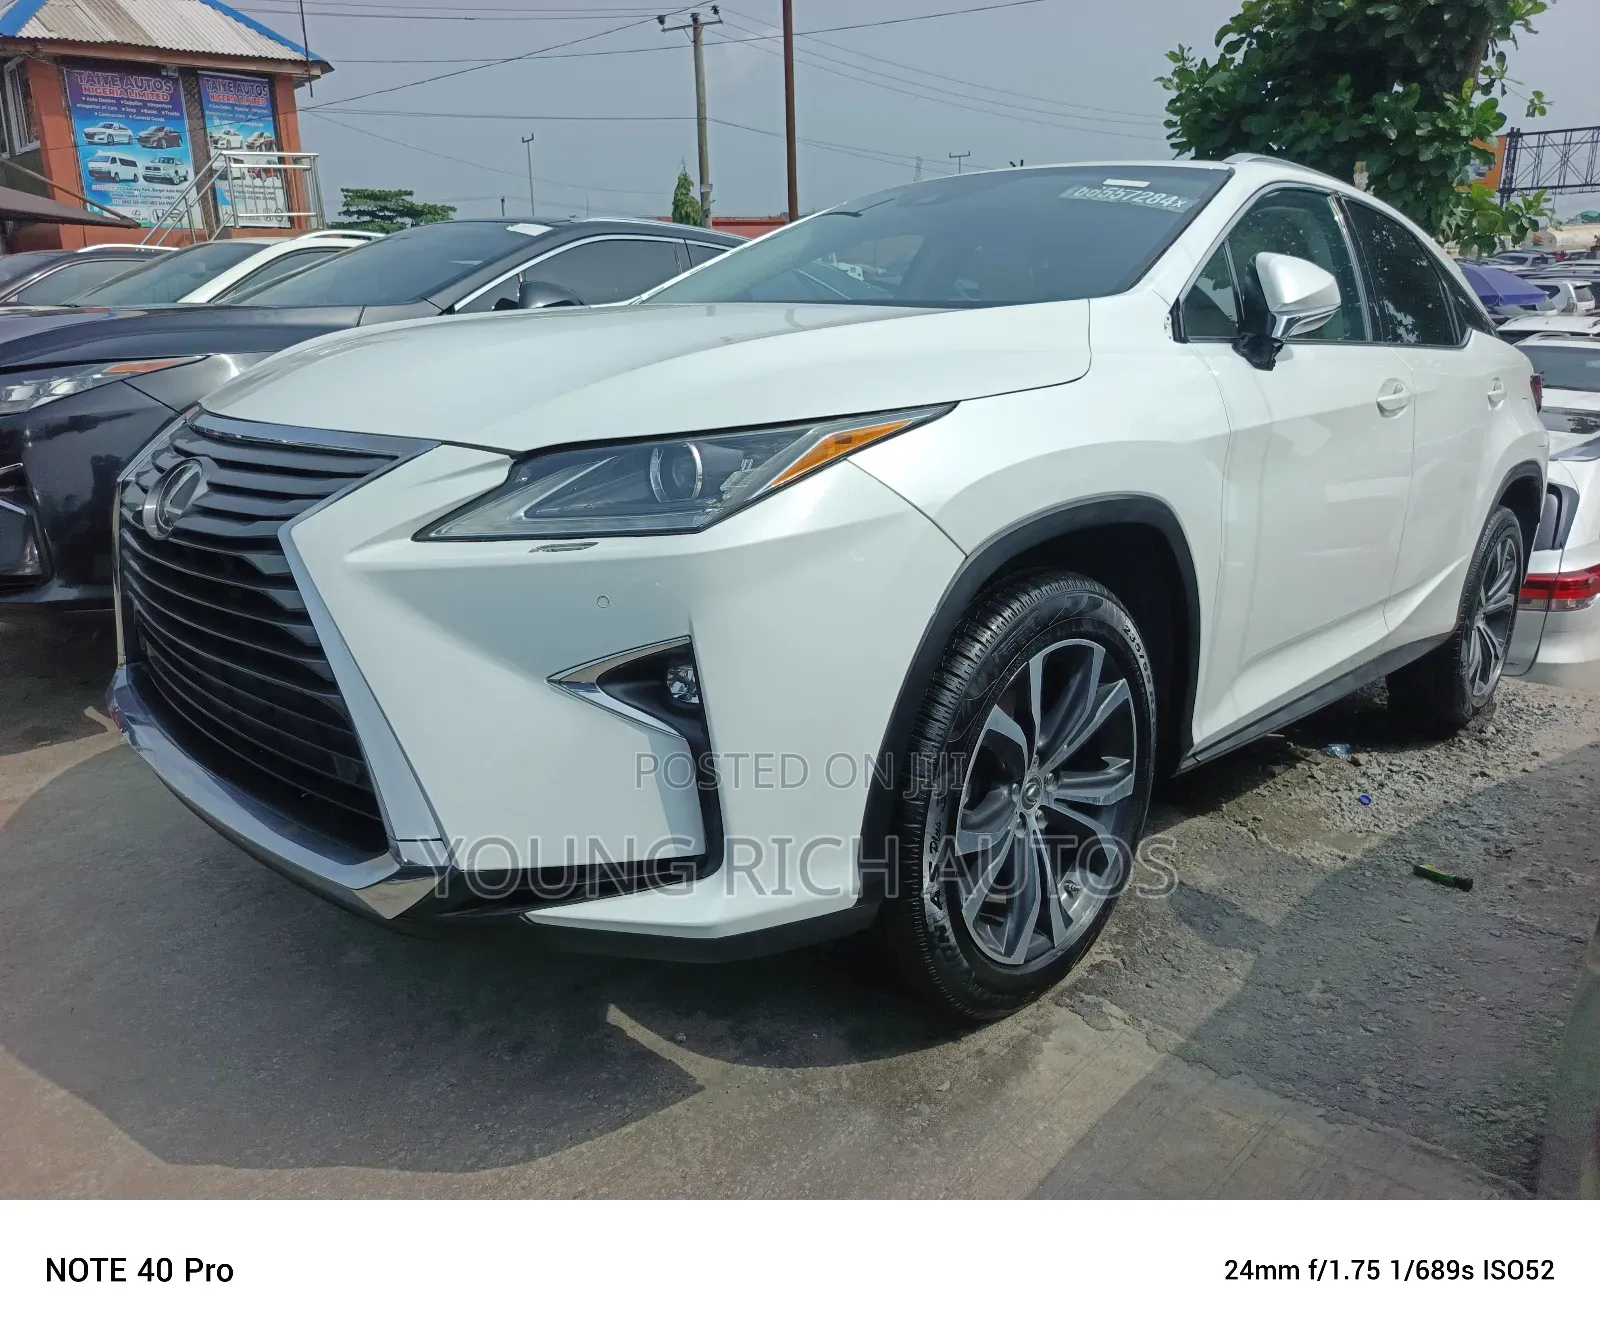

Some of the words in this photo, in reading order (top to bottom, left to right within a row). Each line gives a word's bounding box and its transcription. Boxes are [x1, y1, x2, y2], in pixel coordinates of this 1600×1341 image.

[74, 69, 120, 88] TAIYE
[122, 75, 174, 94] AUTOS
[203, 77, 235, 95] TAIYE
[235, 81, 270, 98] AUTOS
[82, 85, 127, 99] NIGERIA
[127, 90, 170, 102] LIMITED
[209, 93, 239, 105] NIGERIA
[239, 95, 267, 107] LIMITED
